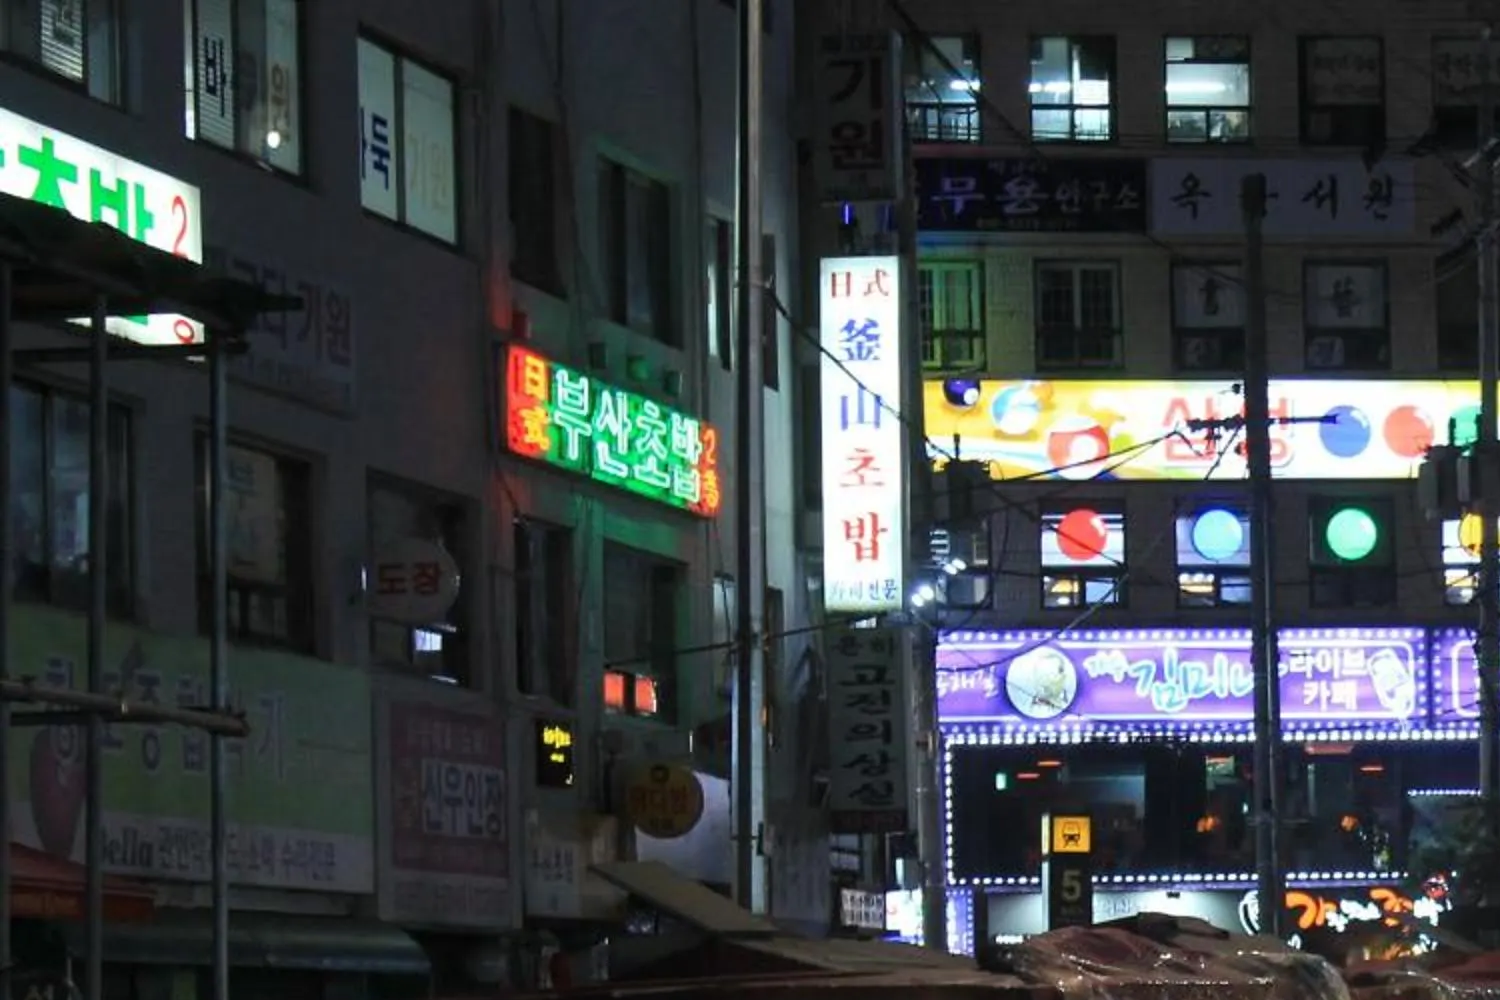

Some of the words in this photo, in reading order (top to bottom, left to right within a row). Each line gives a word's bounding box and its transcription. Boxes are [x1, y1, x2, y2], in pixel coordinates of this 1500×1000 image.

[828, 57, 884, 171] 기원
[1168, 173, 1396, 223] 옥서원
[830, 270, 889, 300] 日式
[552, 369, 703, 505] 부산초밥
[838, 317, 888, 563] 釜山초밥
[377, 562, 442, 595] 도장
[1288, 649, 1370, 678] 라이브
[1302, 680, 1351, 712] 카페
[422, 762, 503, 837] 신우인장
[100, 826, 154, 872] ella
[1062, 868, 1081, 903] 5
